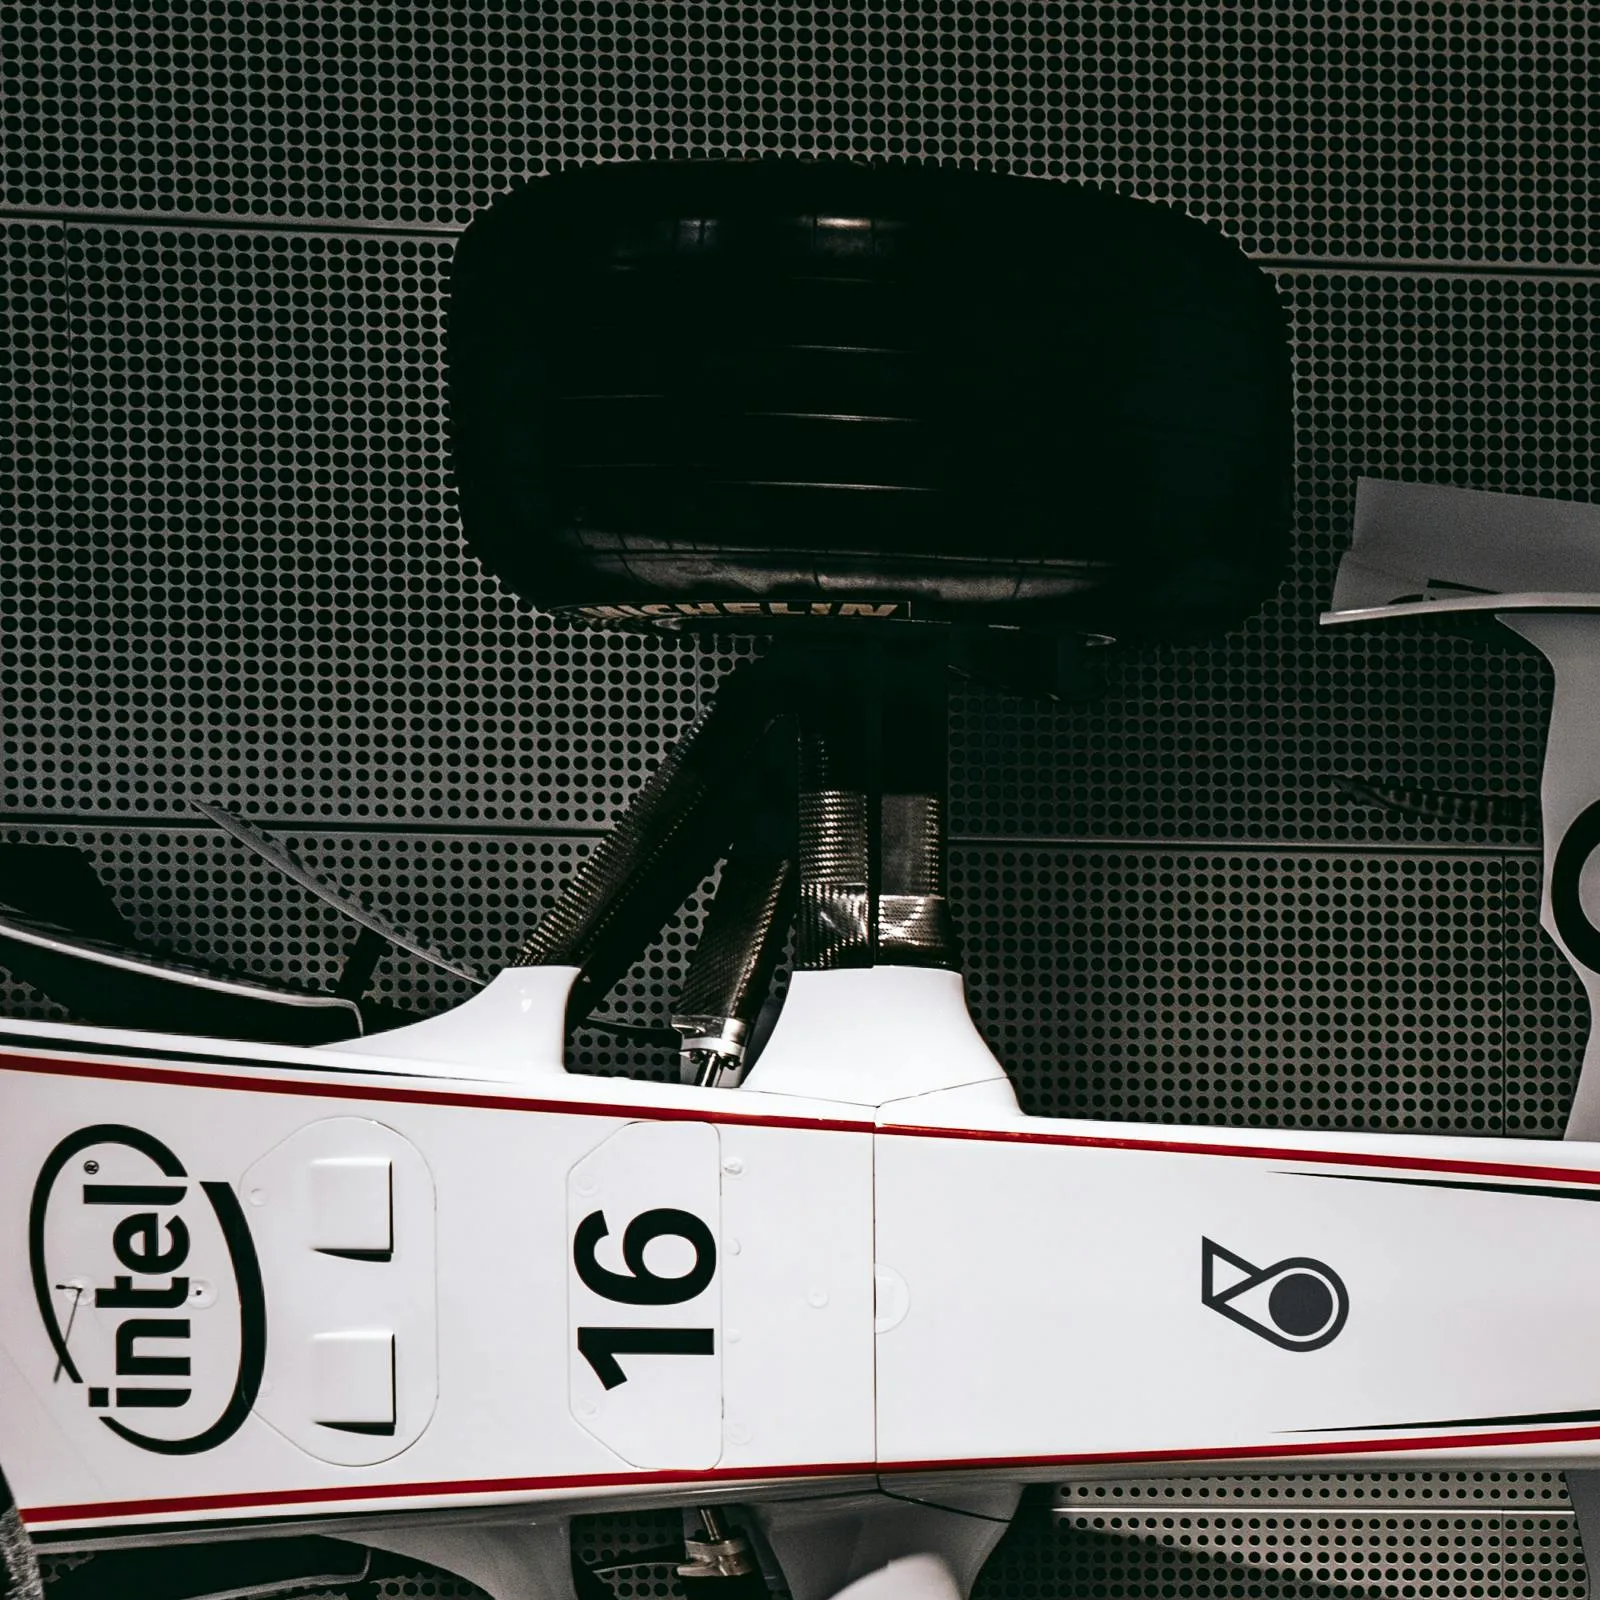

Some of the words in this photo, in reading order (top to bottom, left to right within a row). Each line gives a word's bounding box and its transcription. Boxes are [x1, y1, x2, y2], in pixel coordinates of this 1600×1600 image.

[579, 601, 899, 618] MICHELIN
[82, 1181, 191, 1408] intel
[572, 1207, 718, 1392] 16
